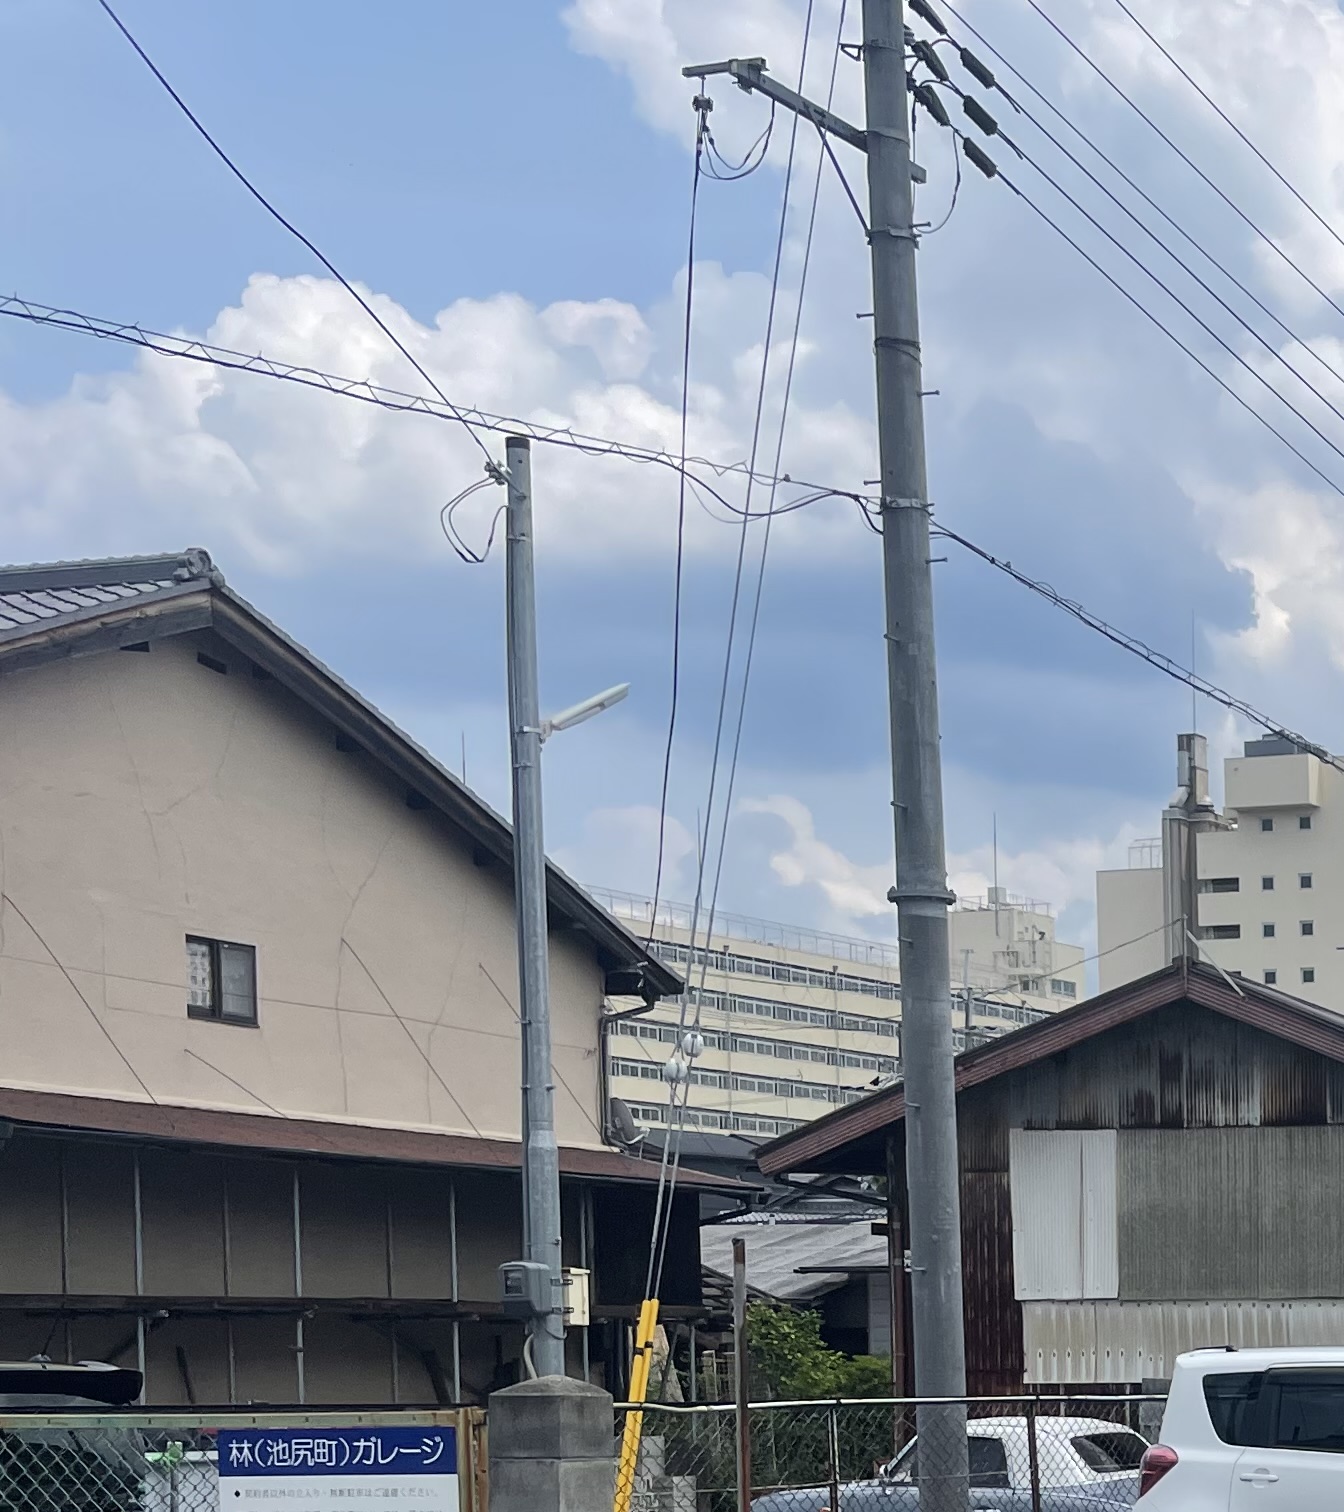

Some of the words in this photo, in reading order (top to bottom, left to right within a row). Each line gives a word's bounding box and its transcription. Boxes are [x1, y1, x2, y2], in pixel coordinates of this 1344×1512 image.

[228, 1436, 444, 1468] 林（池尻町）ガレージ
